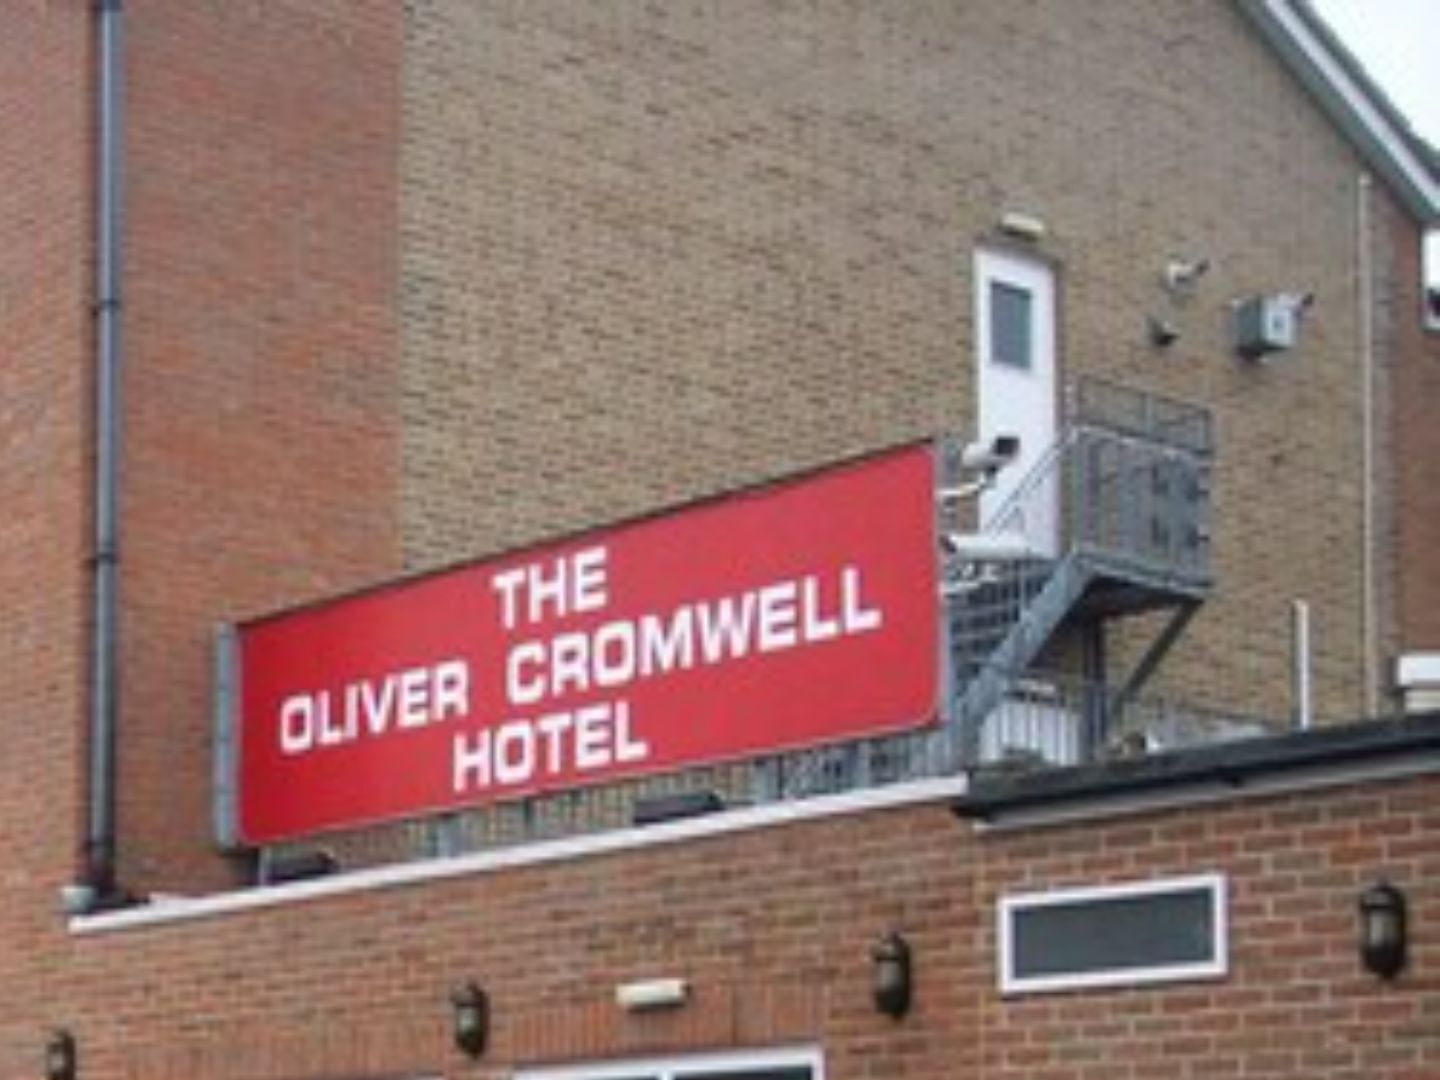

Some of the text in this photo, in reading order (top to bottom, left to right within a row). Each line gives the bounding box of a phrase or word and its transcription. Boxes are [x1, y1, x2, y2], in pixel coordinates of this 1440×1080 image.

[491, 546, 608, 630] THE
[279, 567, 882, 754] OLIVER CROMWELL
[452, 701, 649, 792] HOTEL
